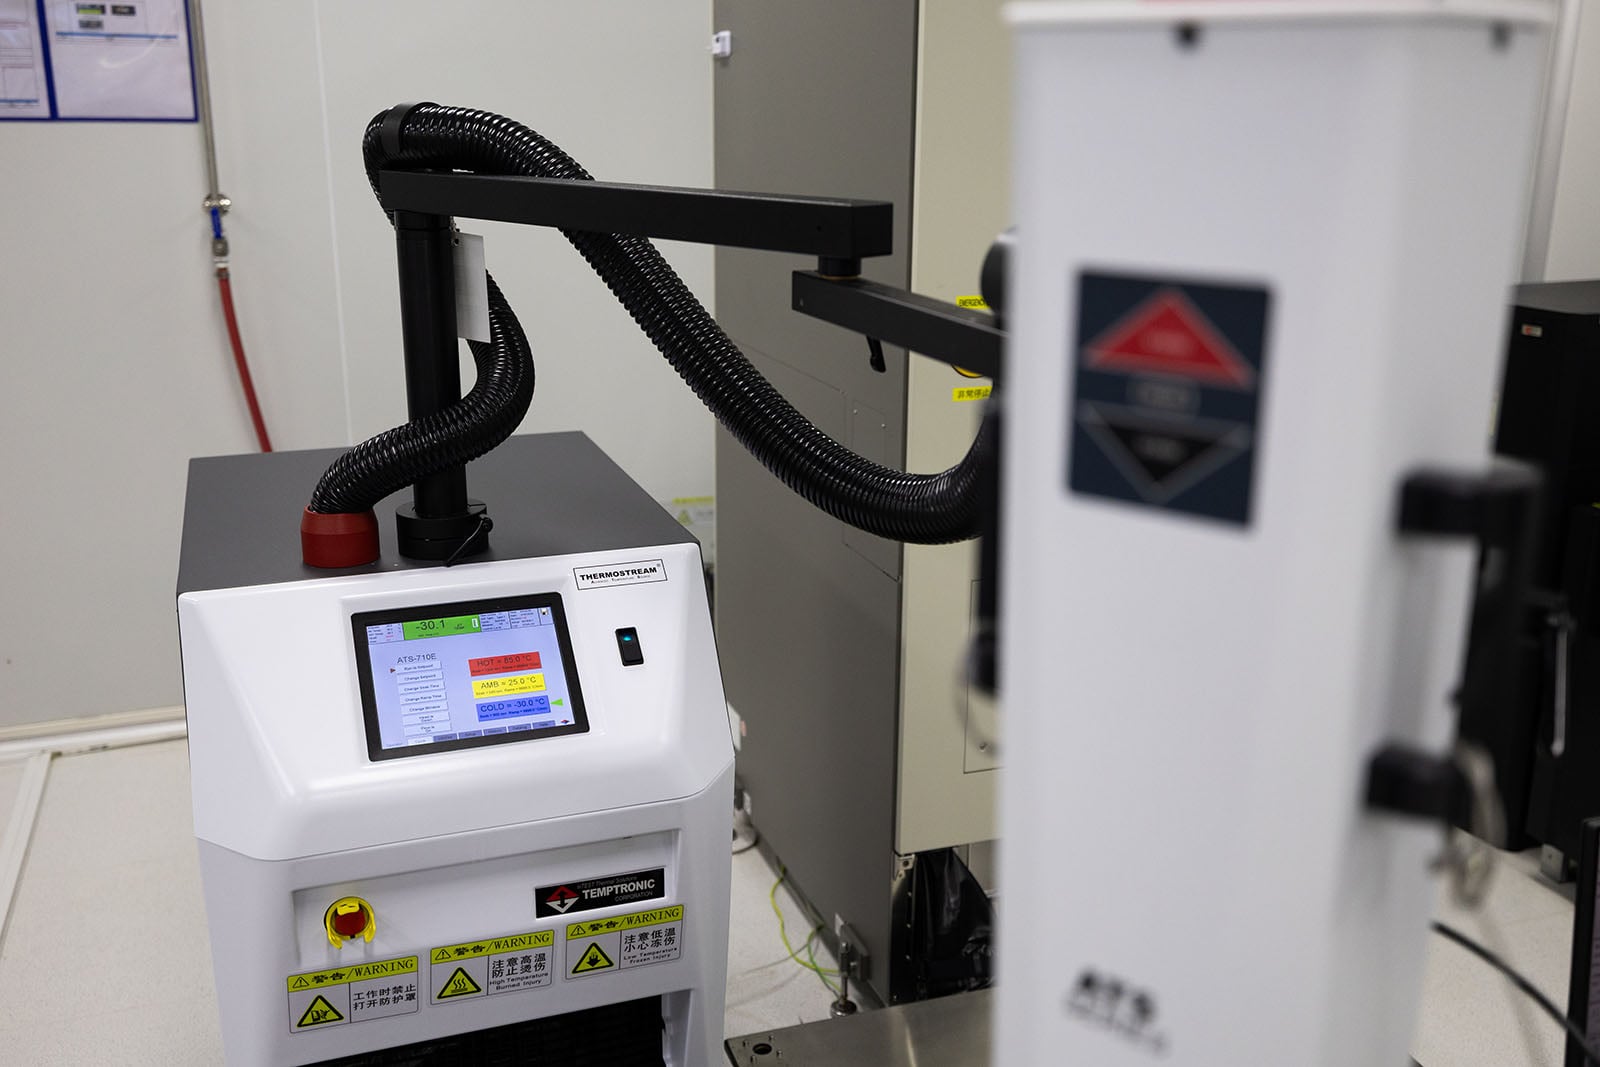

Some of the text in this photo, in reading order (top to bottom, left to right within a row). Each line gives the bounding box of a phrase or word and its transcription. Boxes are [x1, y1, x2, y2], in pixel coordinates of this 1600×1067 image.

[416, 619, 446, 631] -30.1
[397, 653, 437, 664] ATS-710E
[477, 658, 494, 667] HOT
[504, 656, 521, 664] 85.0
[481, 681, 500, 689] AMB
[508, 677, 526, 686] 25.0
[480, 703, 505, 712] COLD
[514, 699, 534, 708] -30.0
[582, 879, 656, 900] TEMPTRONIC
[624, 927, 676, 944] 注意低温
[623, 936, 675, 953] 小心冻伤
[640, 947, 678, 958] Temperature
[492, 953, 546, 969] 注意高温
[491, 962, 546, 979] 防止烫伤
[490, 972, 549, 986] High Temperature
[495, 980, 541, 990] Burned Injury
[353, 984, 416, 1001] 工作时禁止
[353, 993, 416, 1011] 打开防护罩
